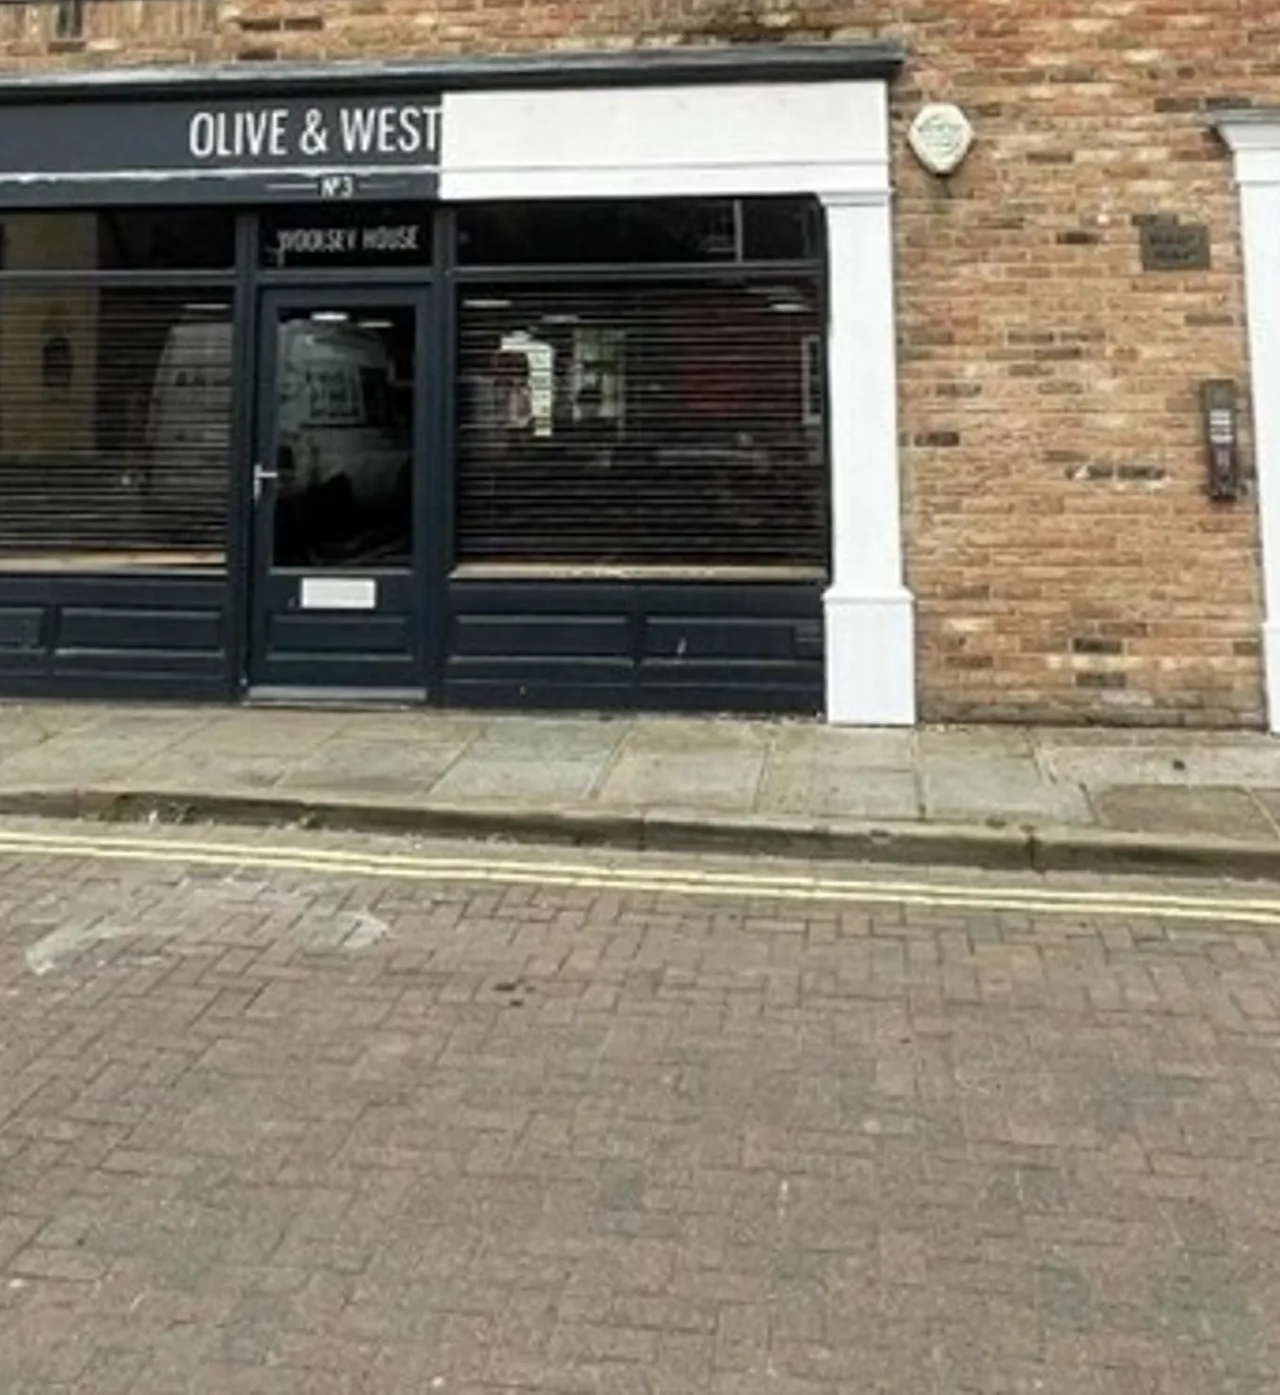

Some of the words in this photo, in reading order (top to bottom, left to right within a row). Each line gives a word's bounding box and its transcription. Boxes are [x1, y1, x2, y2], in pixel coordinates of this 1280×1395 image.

[189, 109, 289, 156] OLIVE
[299, 108, 328, 155] &
[340, 105, 443, 152] WEST
[362, 224, 419, 252] HOUSE
